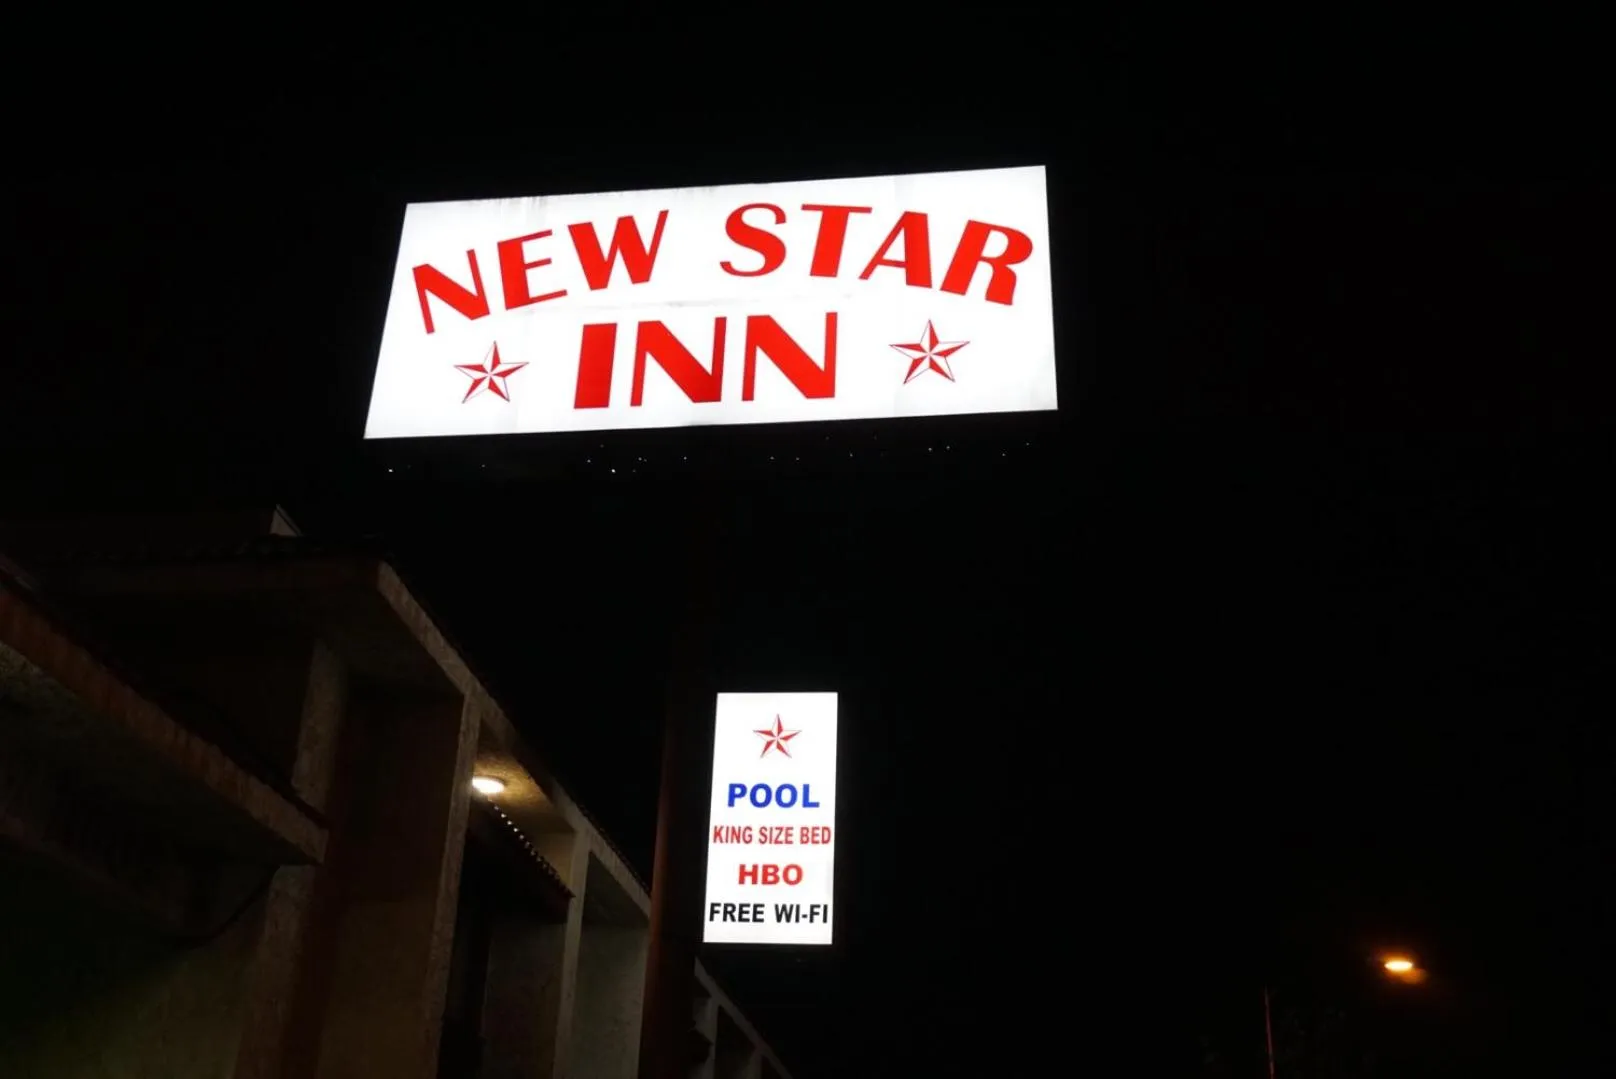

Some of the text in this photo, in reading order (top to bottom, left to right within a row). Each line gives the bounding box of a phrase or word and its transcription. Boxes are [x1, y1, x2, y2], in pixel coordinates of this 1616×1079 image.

[412, 204, 1033, 333] NEW STAR
[574, 311, 838, 409] INN
[727, 783, 820, 808] POOL
[713, 825, 832, 845] KING SIZE BED
[738, 864, 804, 885] HBO
[709, 902, 828, 924] FREE WI-FI
